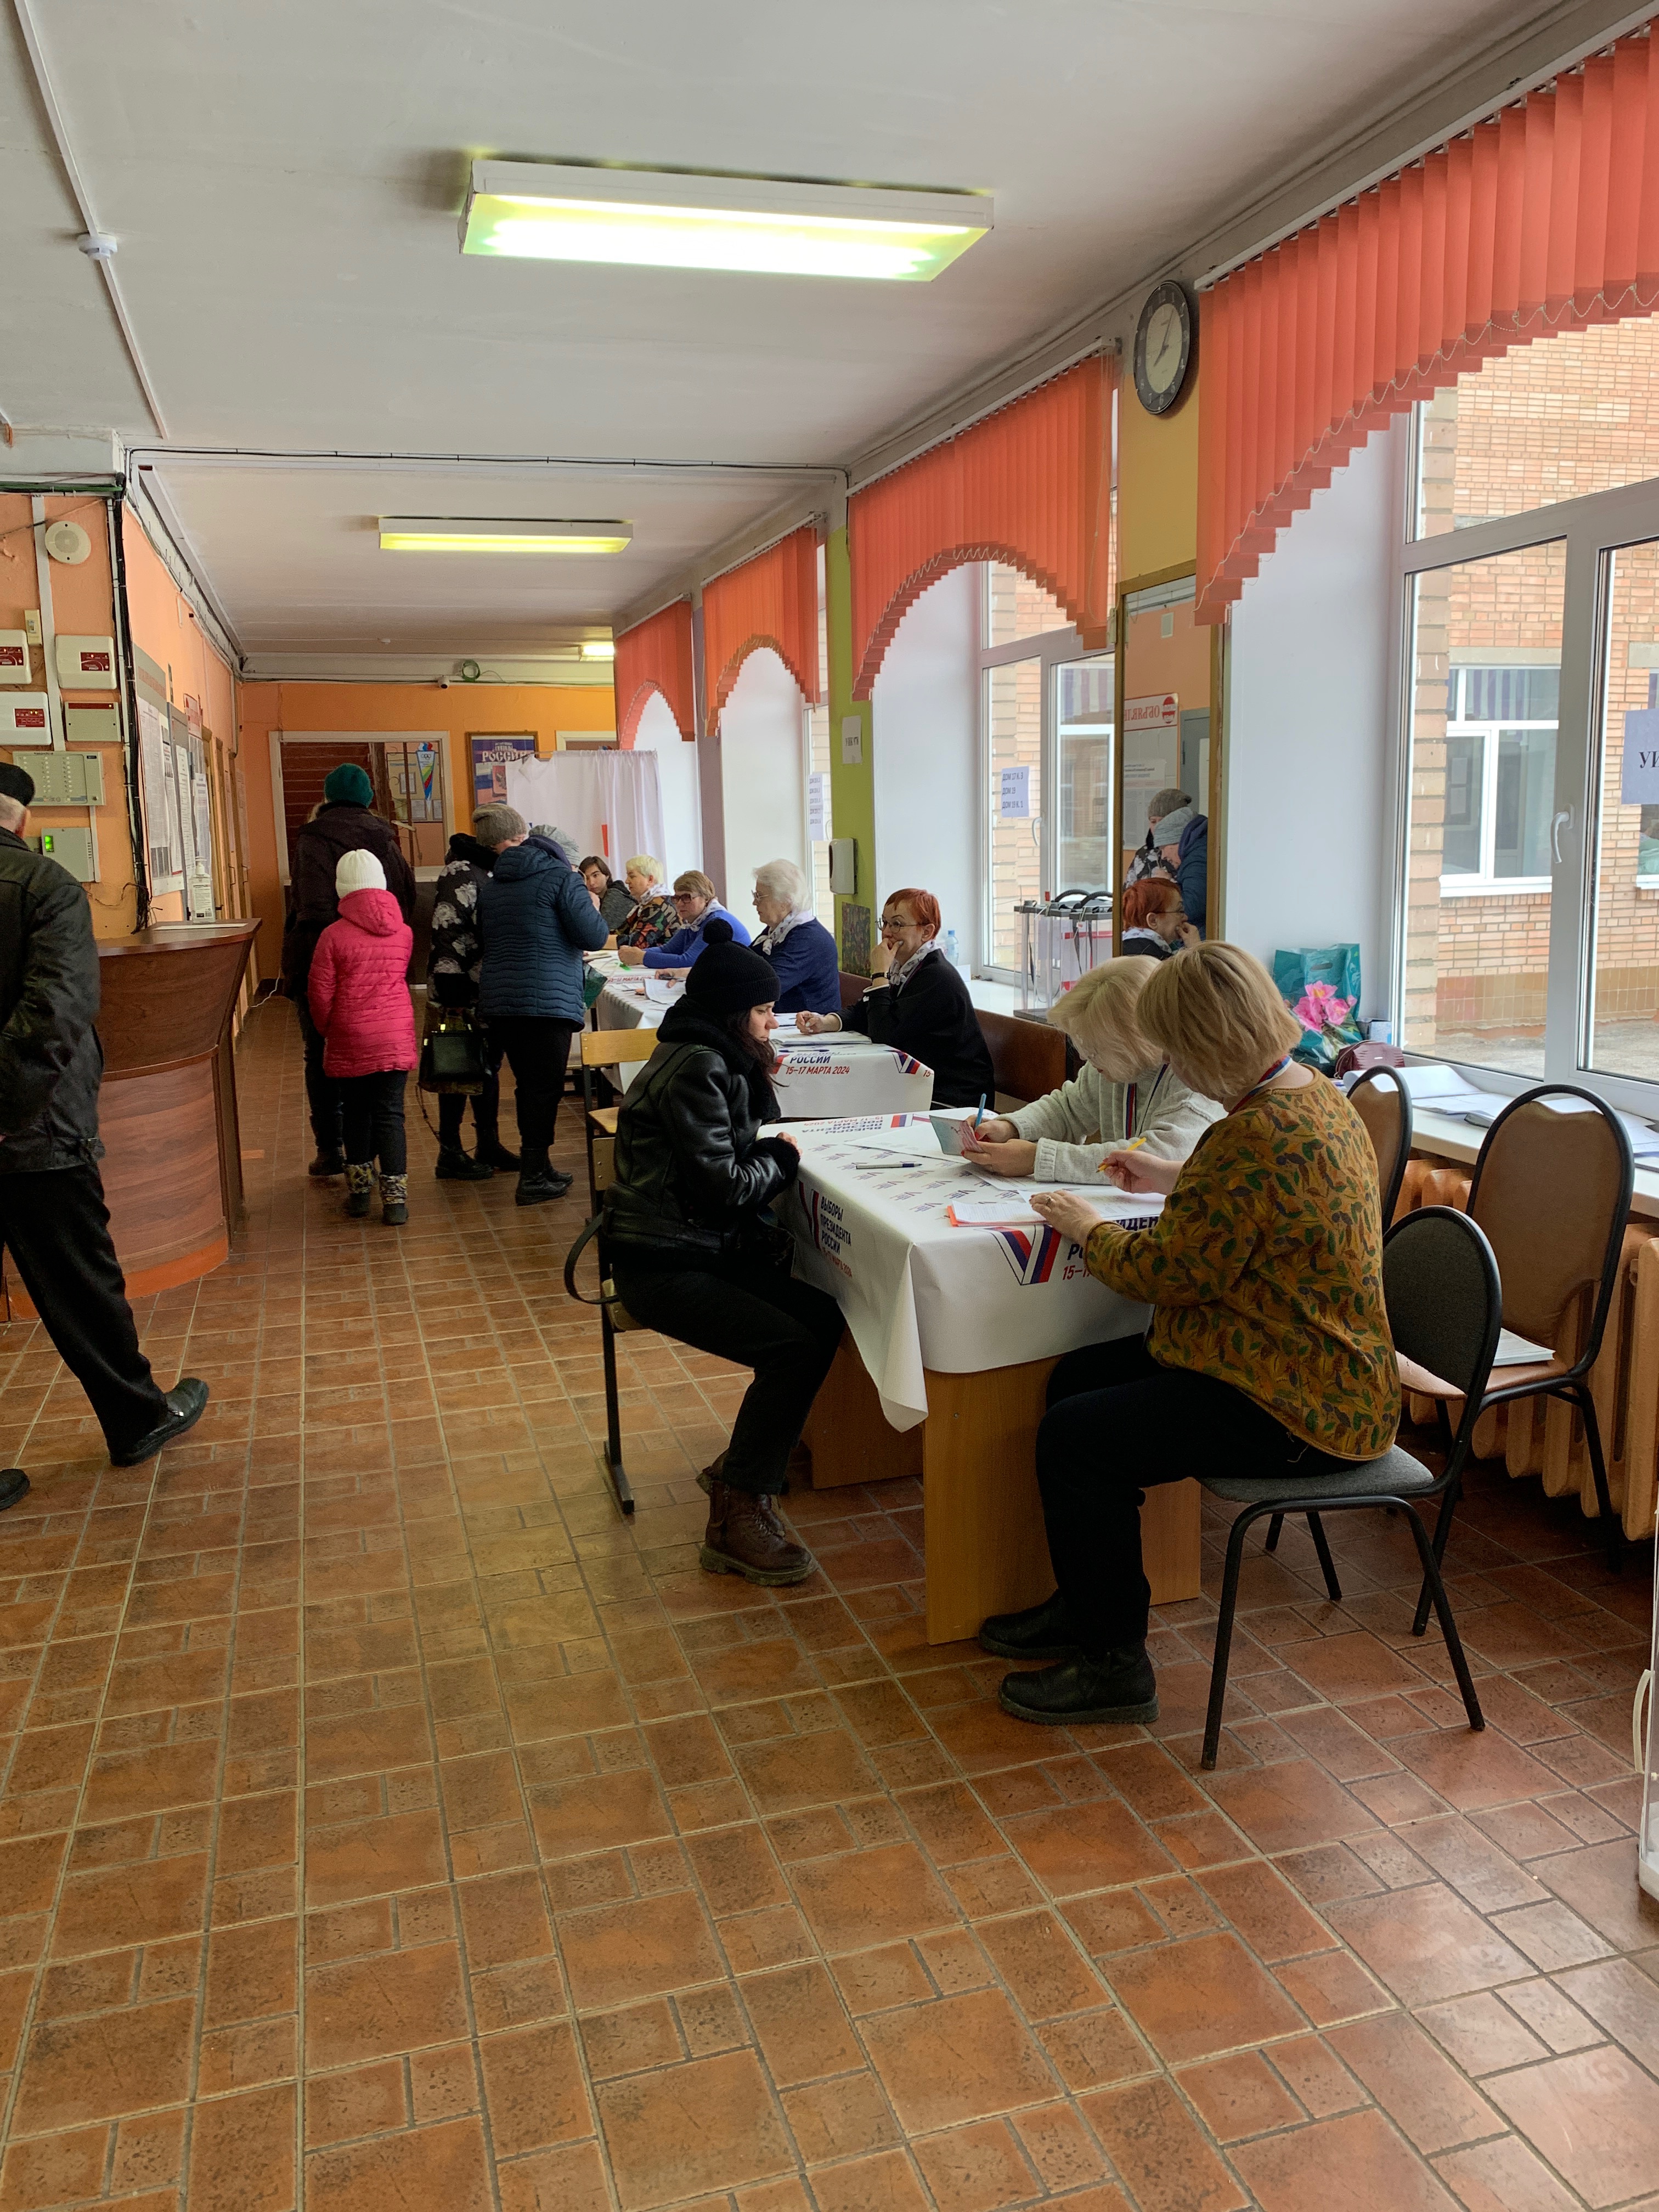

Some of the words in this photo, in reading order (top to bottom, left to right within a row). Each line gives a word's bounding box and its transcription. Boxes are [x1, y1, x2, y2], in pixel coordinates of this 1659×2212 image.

[789, 1056, 831, 1064] РОССИИ
[806, 1066, 832, 1075] МАРТА
[832, 1066, 850, 1074] 2024
[821, 1196, 843, 1222] ВЫБОРЫ
[820, 1214, 851, 1247] ПРЕЗИДЕНТА
[822, 1229, 840, 1255] РОССИИ
